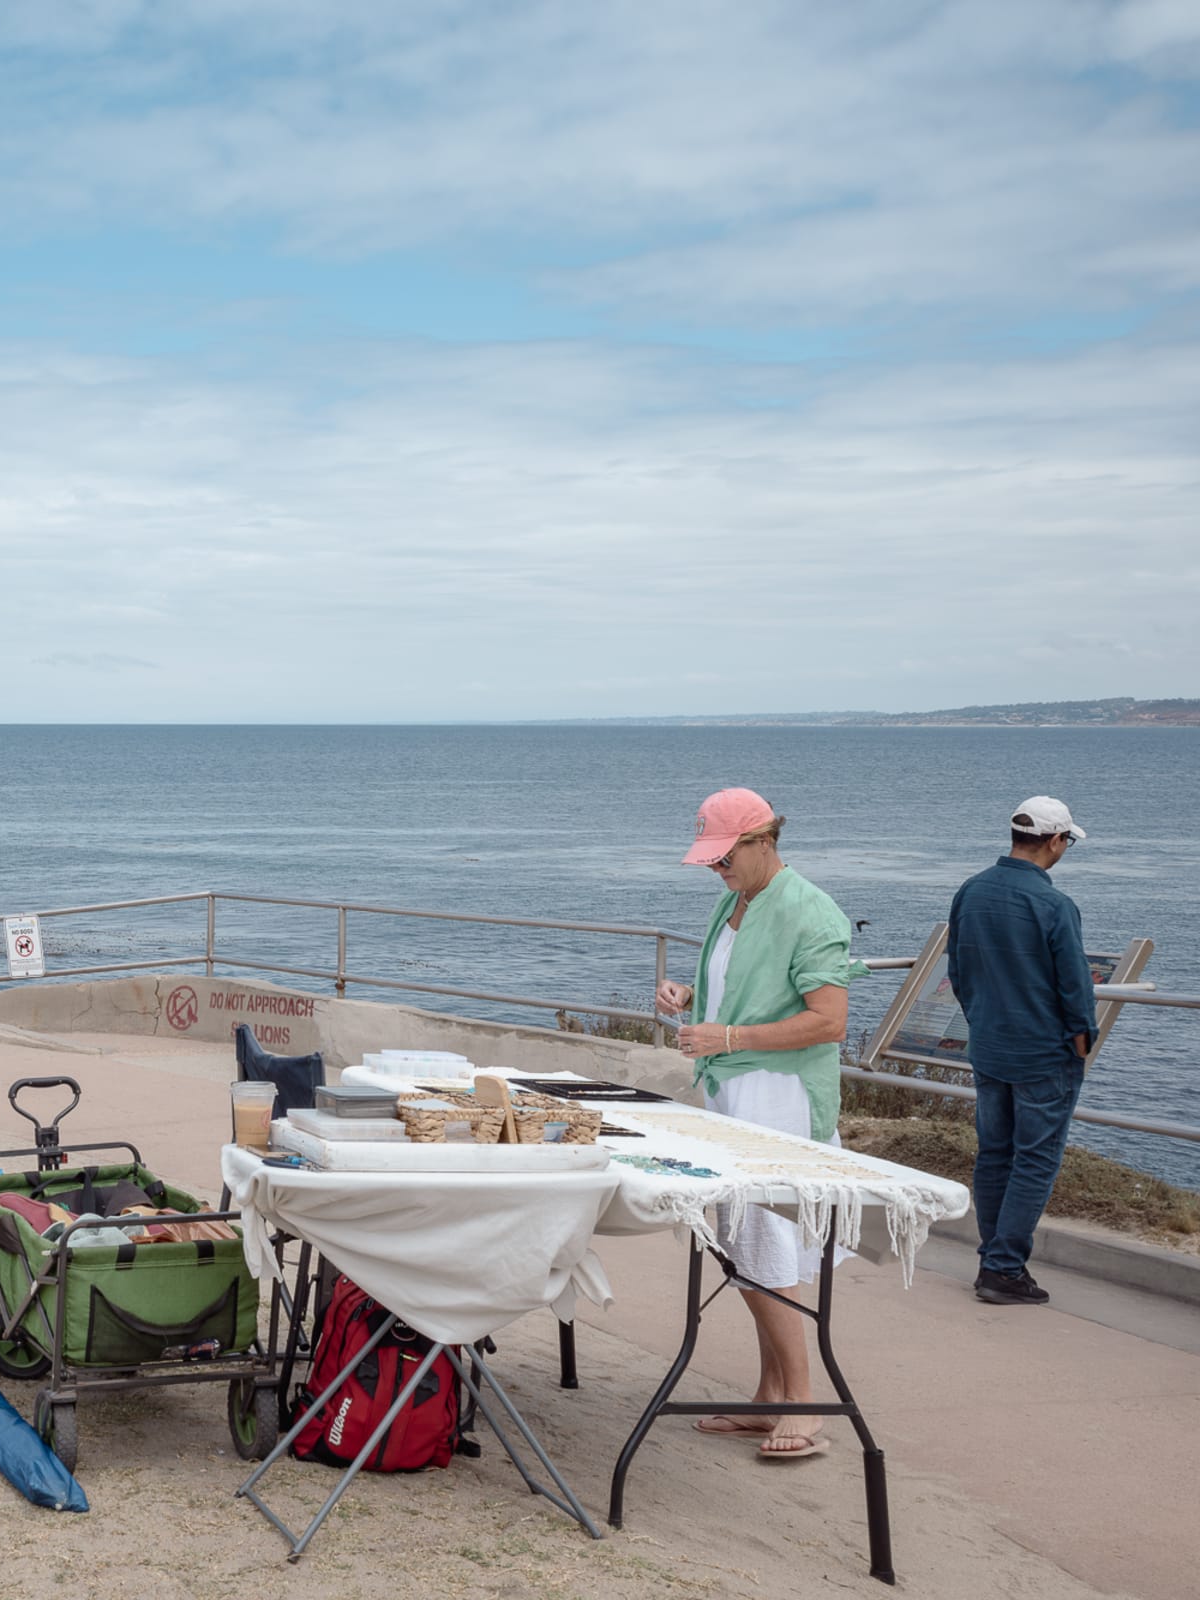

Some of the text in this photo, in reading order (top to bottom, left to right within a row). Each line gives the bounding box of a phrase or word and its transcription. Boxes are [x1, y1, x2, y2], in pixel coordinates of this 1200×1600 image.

[209, 992, 315, 1017] DO NOT APPROACH
[254, 1023, 291, 1044] LIONS
[328, 1397, 353, 1447] Wilson
